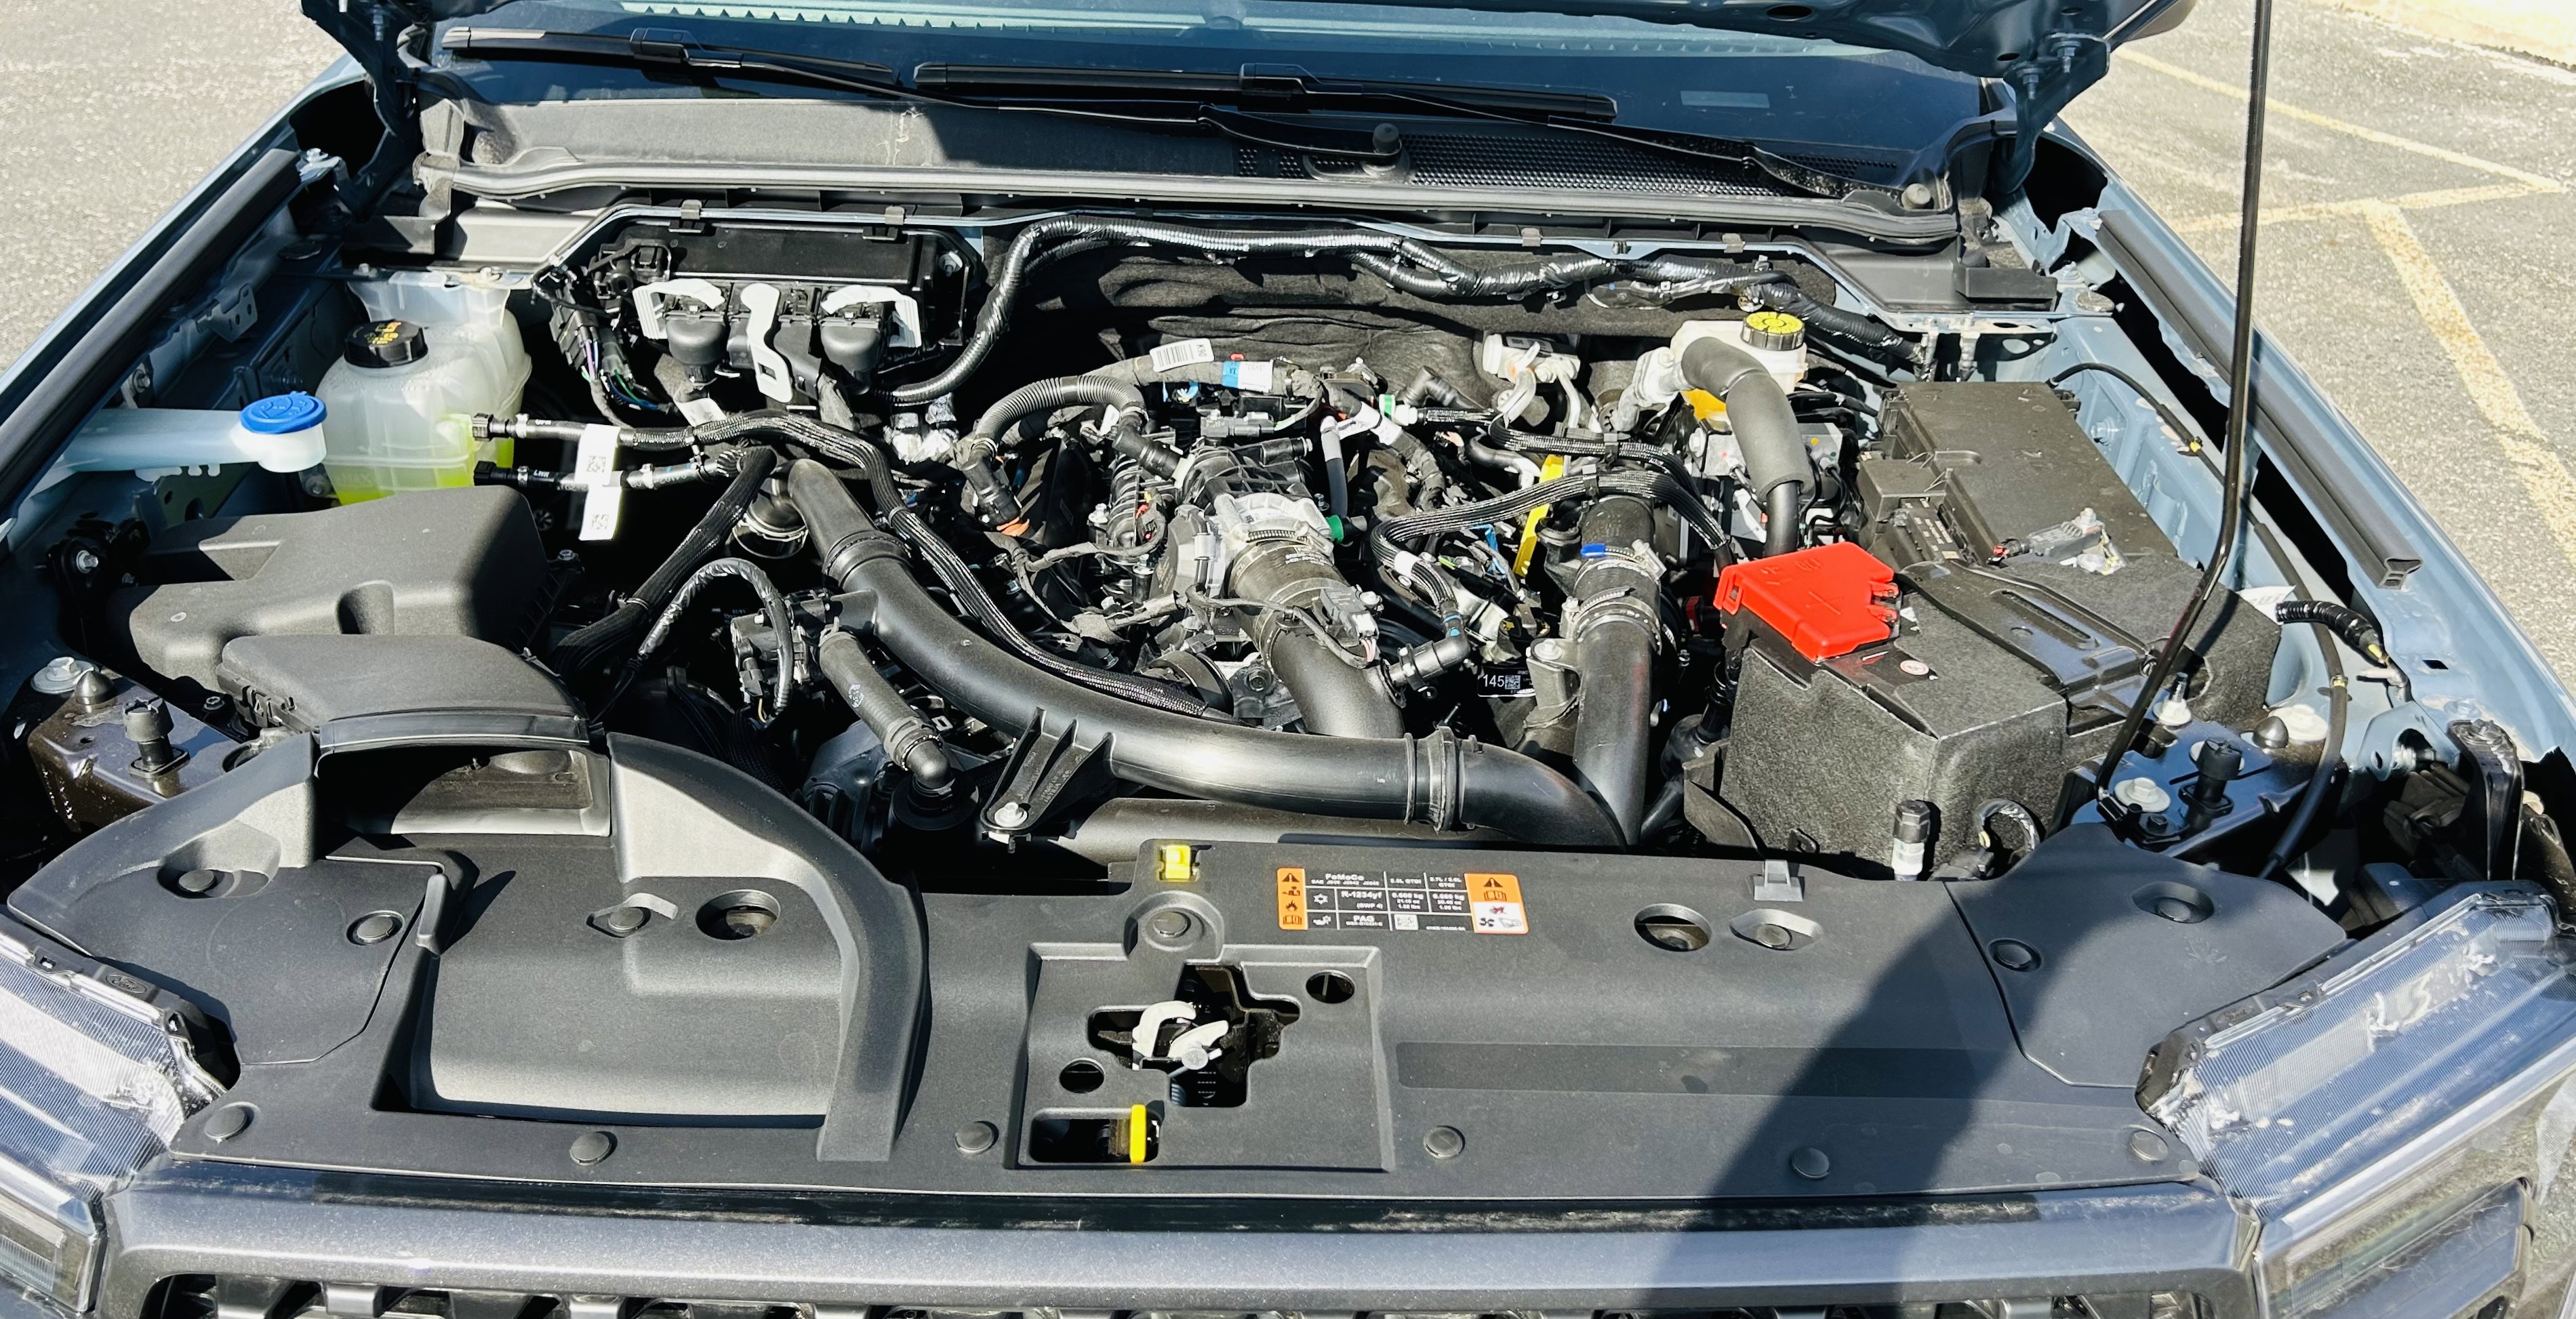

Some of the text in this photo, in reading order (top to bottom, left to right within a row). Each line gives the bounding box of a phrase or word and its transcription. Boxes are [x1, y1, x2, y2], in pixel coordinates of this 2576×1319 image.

[1483, 674, 1505, 687] 145
[1325, 873, 1365, 881] FoMoCo
[1341, 891, 1382, 899] R-1234yf
